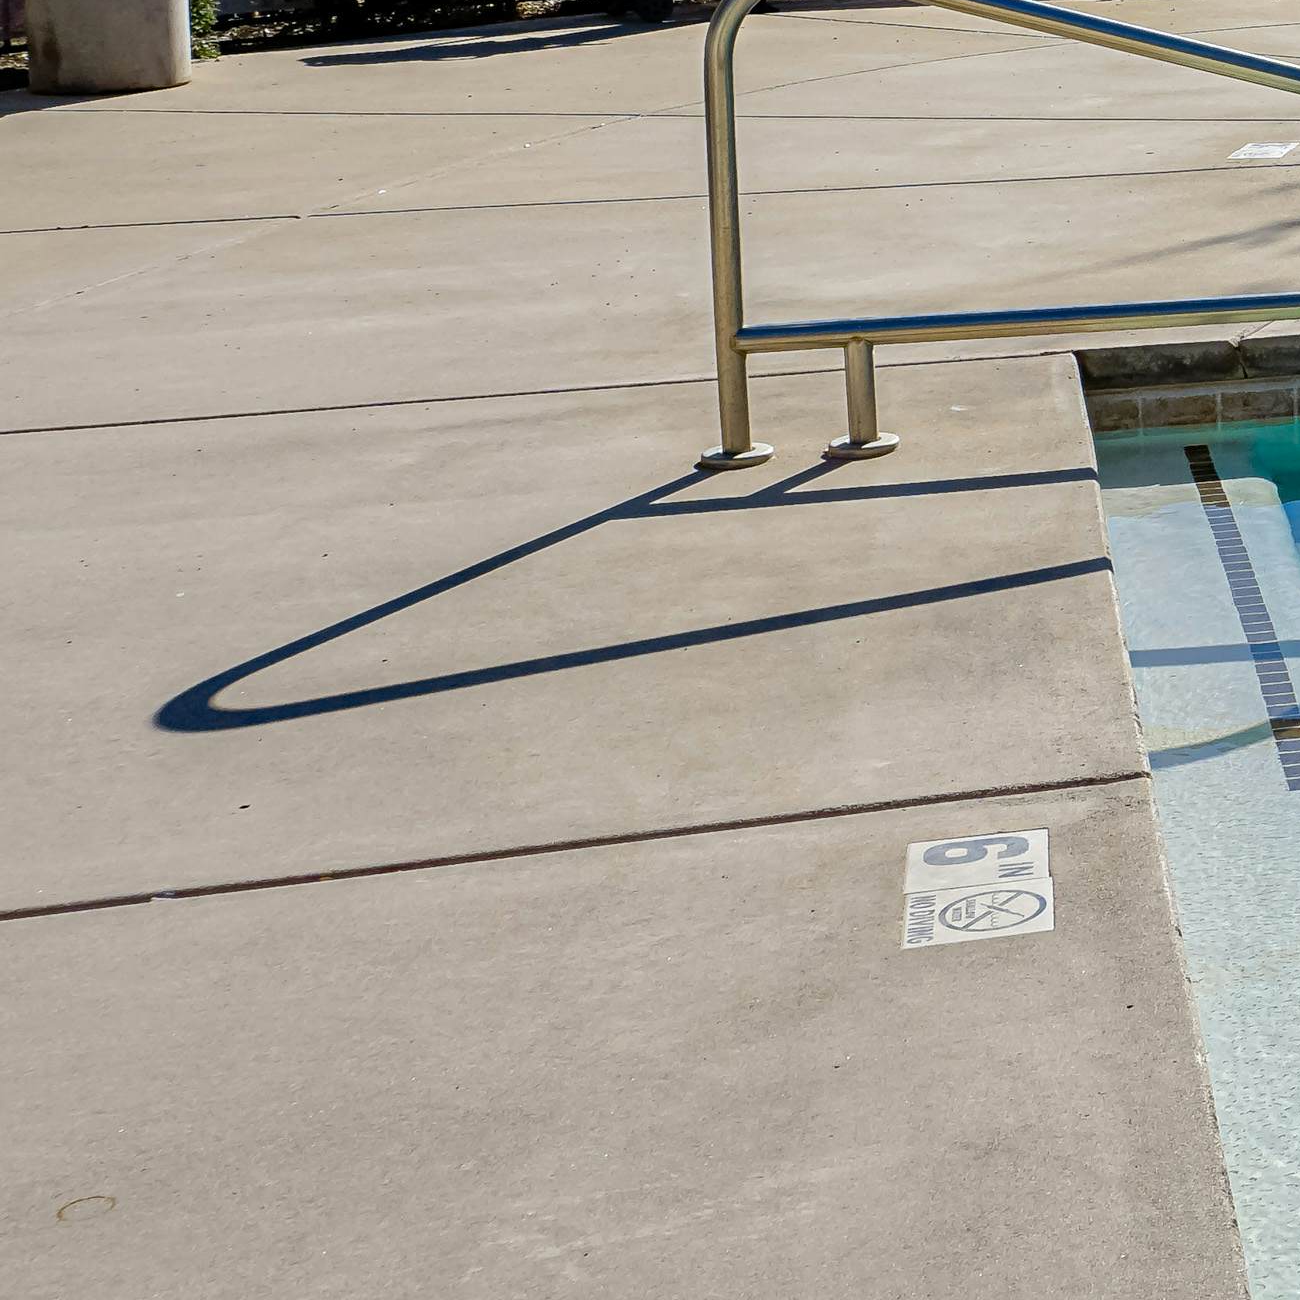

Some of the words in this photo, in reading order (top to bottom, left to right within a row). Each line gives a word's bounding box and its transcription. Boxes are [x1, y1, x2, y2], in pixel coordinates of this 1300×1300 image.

[923, 836, 1029, 866] 6
[998, 861, 1034, 878] IN
[909, 894, 936, 910] NO
[907, 909, 935, 944] DIVING
